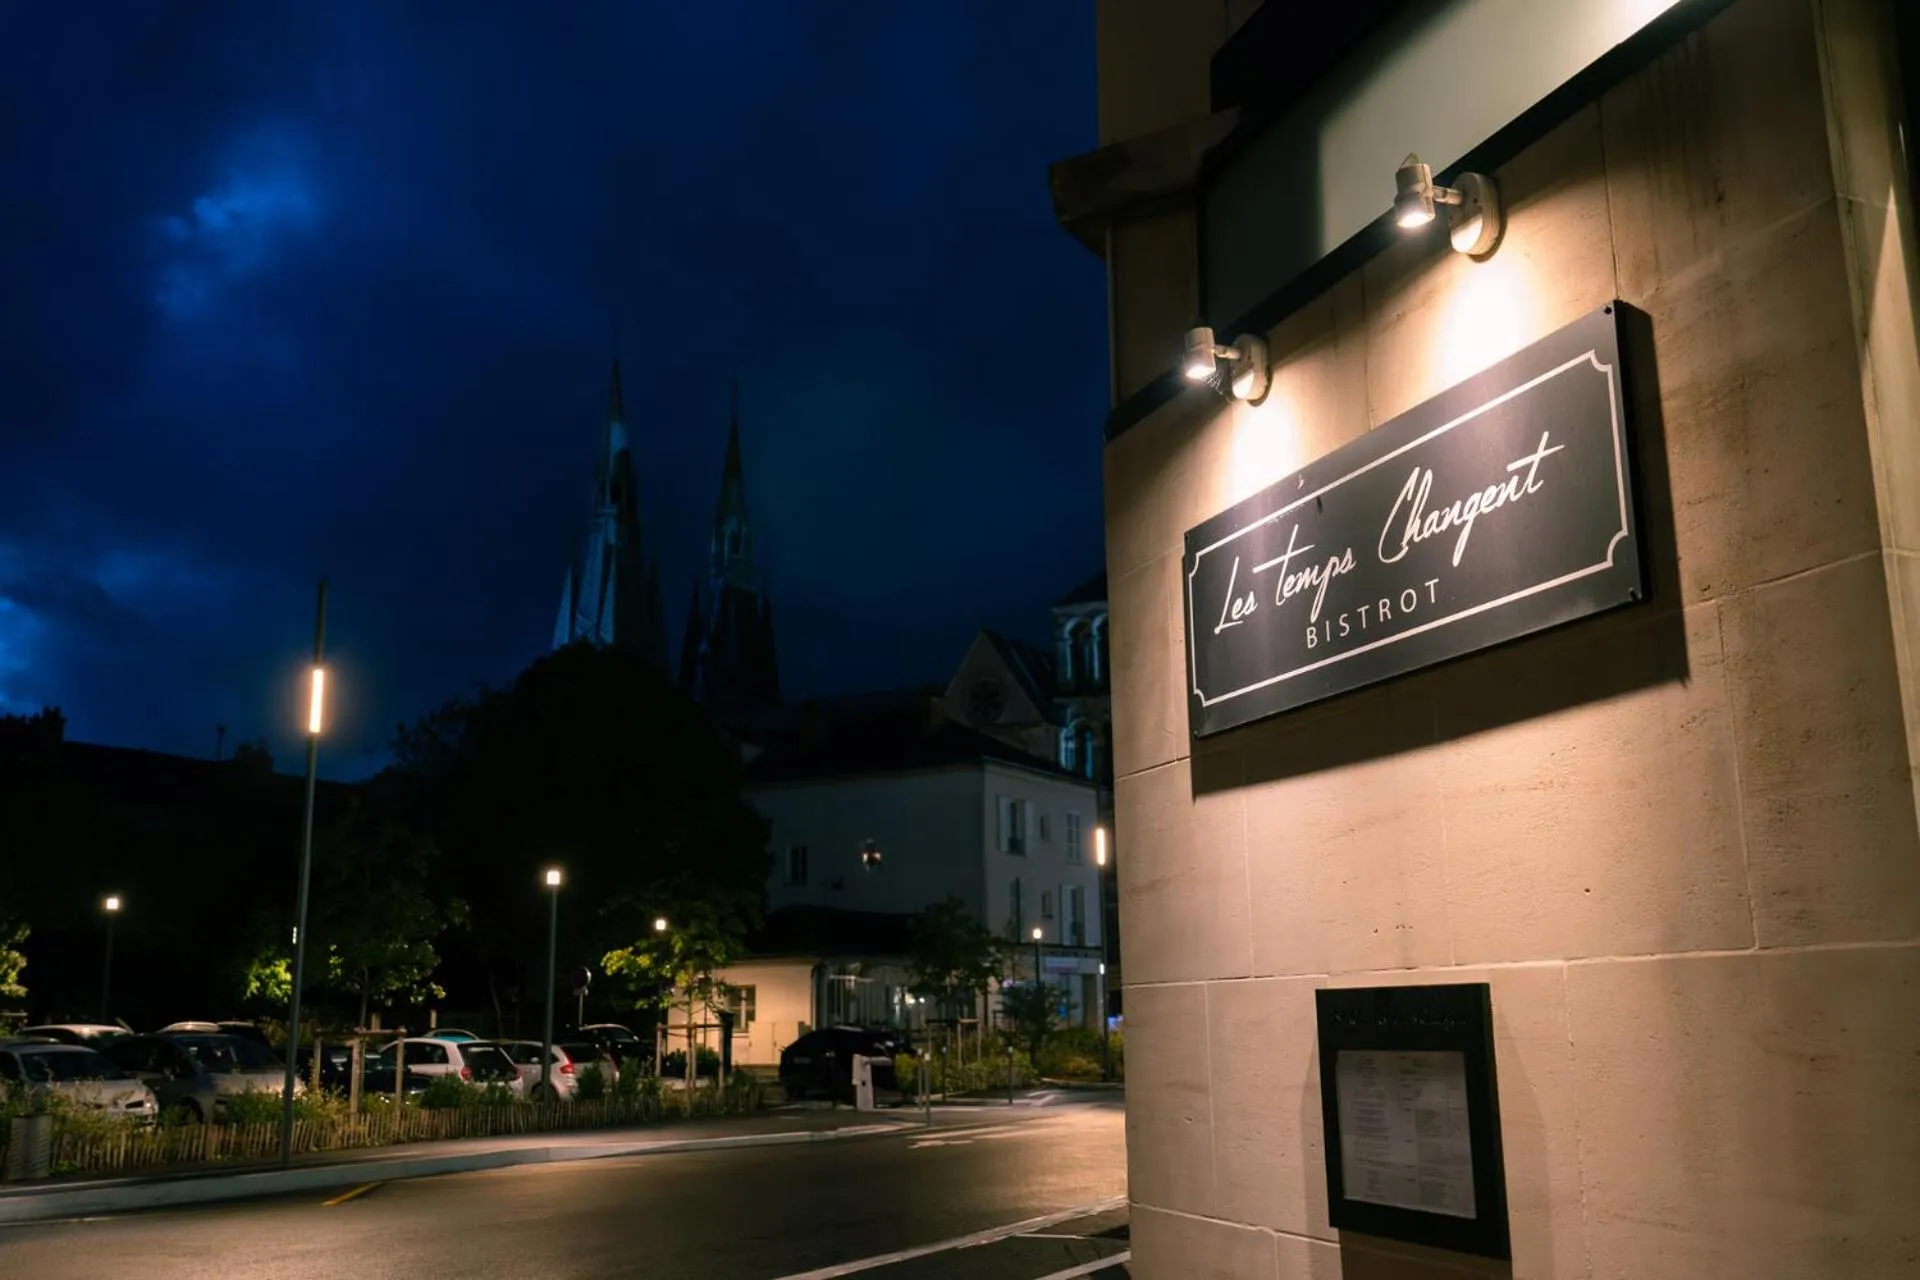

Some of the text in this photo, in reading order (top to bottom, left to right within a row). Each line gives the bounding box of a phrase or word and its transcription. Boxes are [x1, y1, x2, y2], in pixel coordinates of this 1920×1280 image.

[1214, 556, 1258, 635] Les
[1378, 431, 1565, 567] Changent
[1306, 578, 1440, 649] BISTROT
